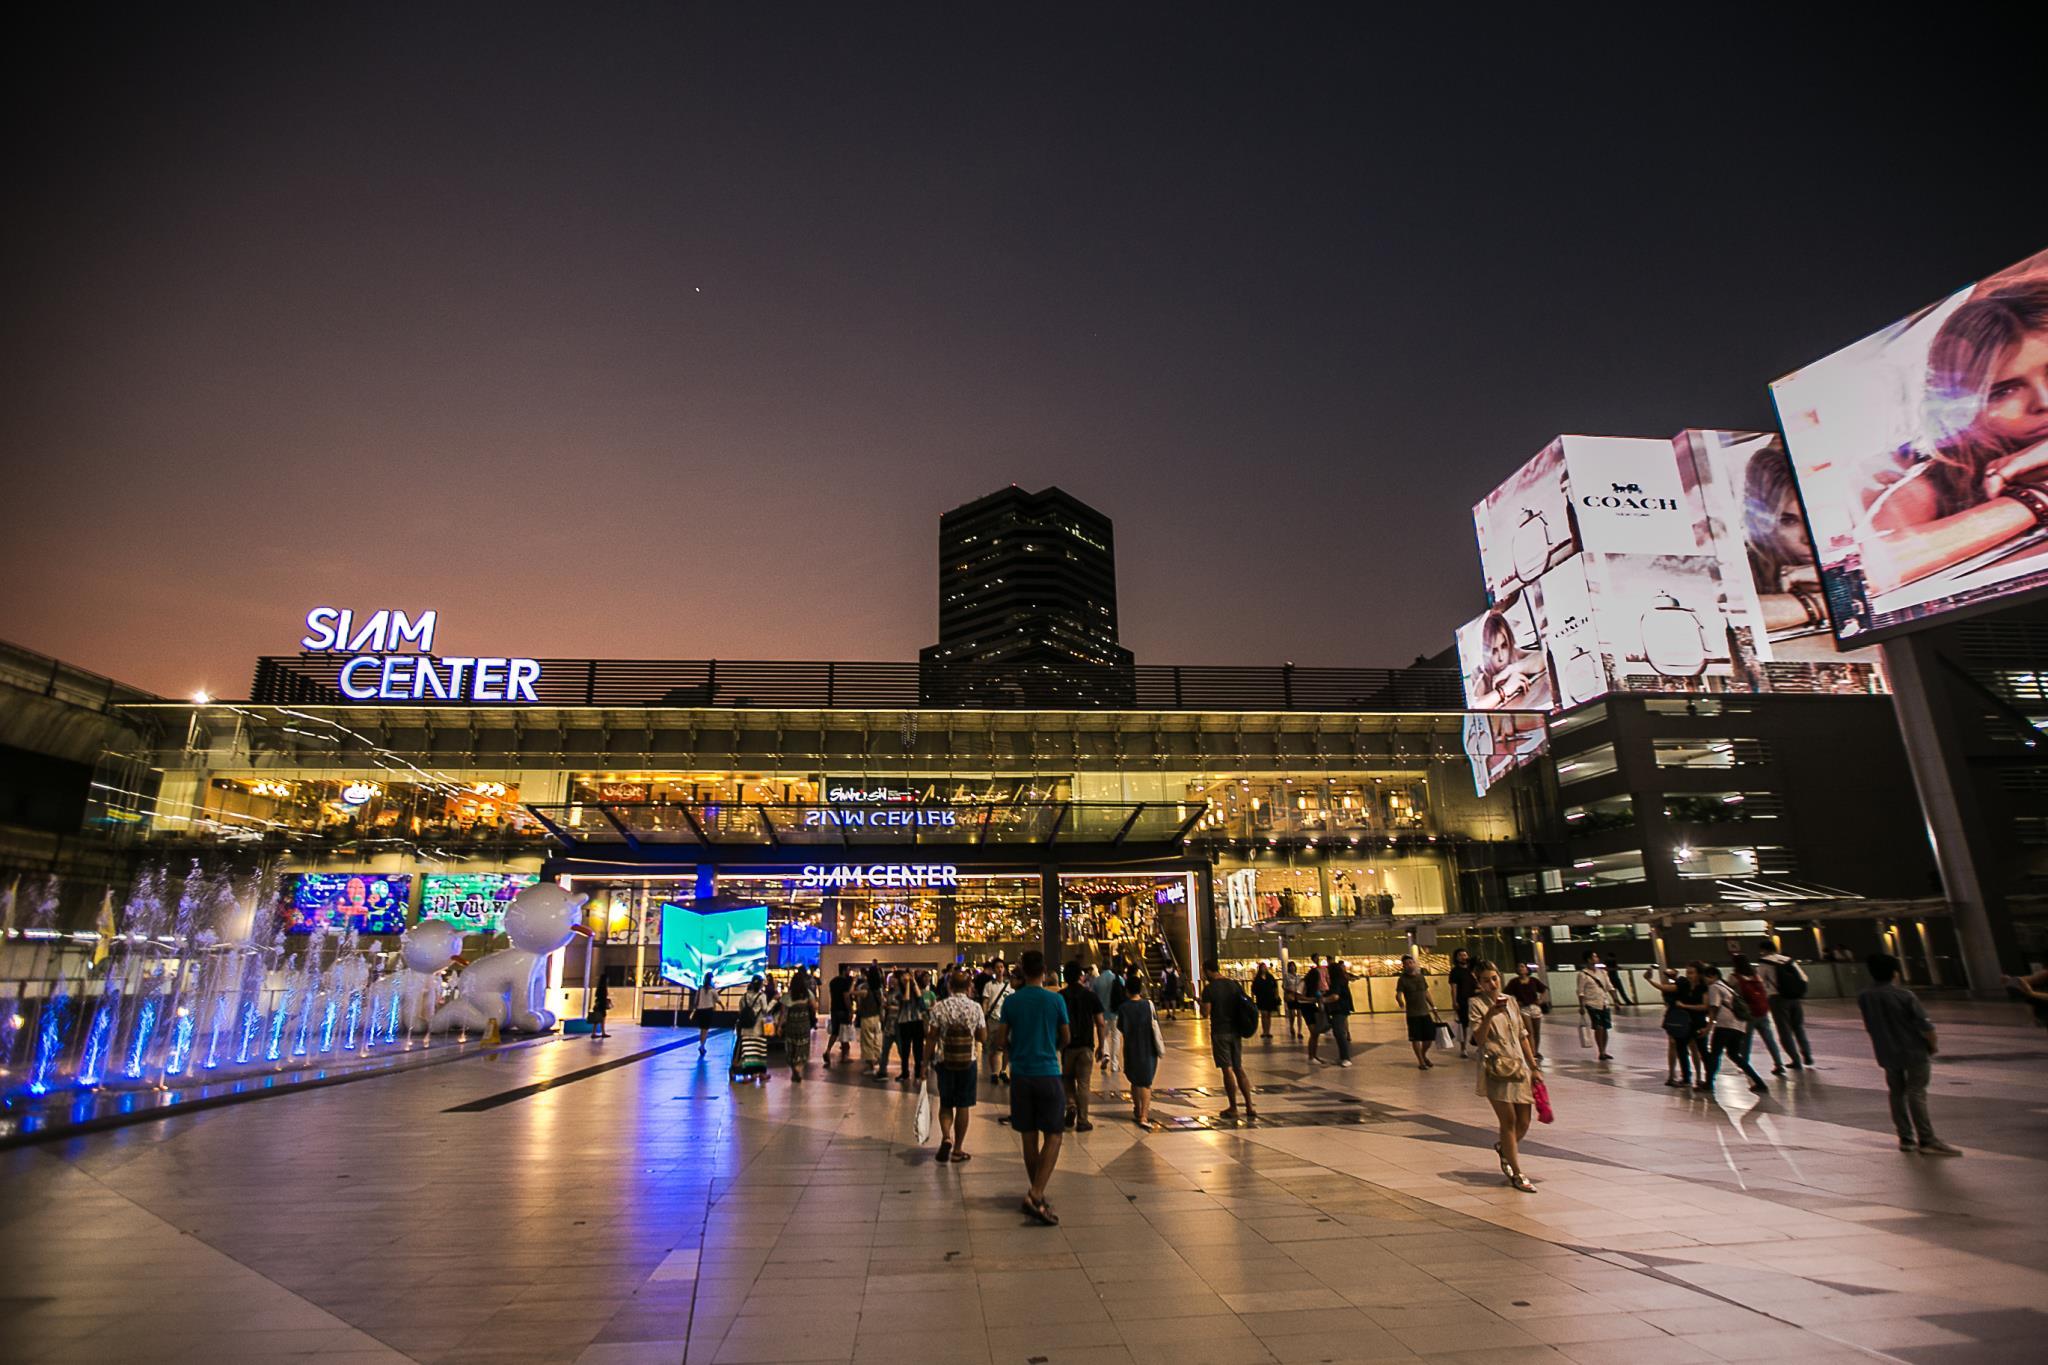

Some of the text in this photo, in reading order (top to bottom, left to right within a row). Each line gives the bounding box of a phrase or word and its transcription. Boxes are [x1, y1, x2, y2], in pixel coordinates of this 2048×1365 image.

[1582, 496, 1677, 510] COACH
[301, 606, 437, 652] SIAM
[338, 656, 541, 701] CENTER
[803, 865, 957, 887] SIAM CENTER
